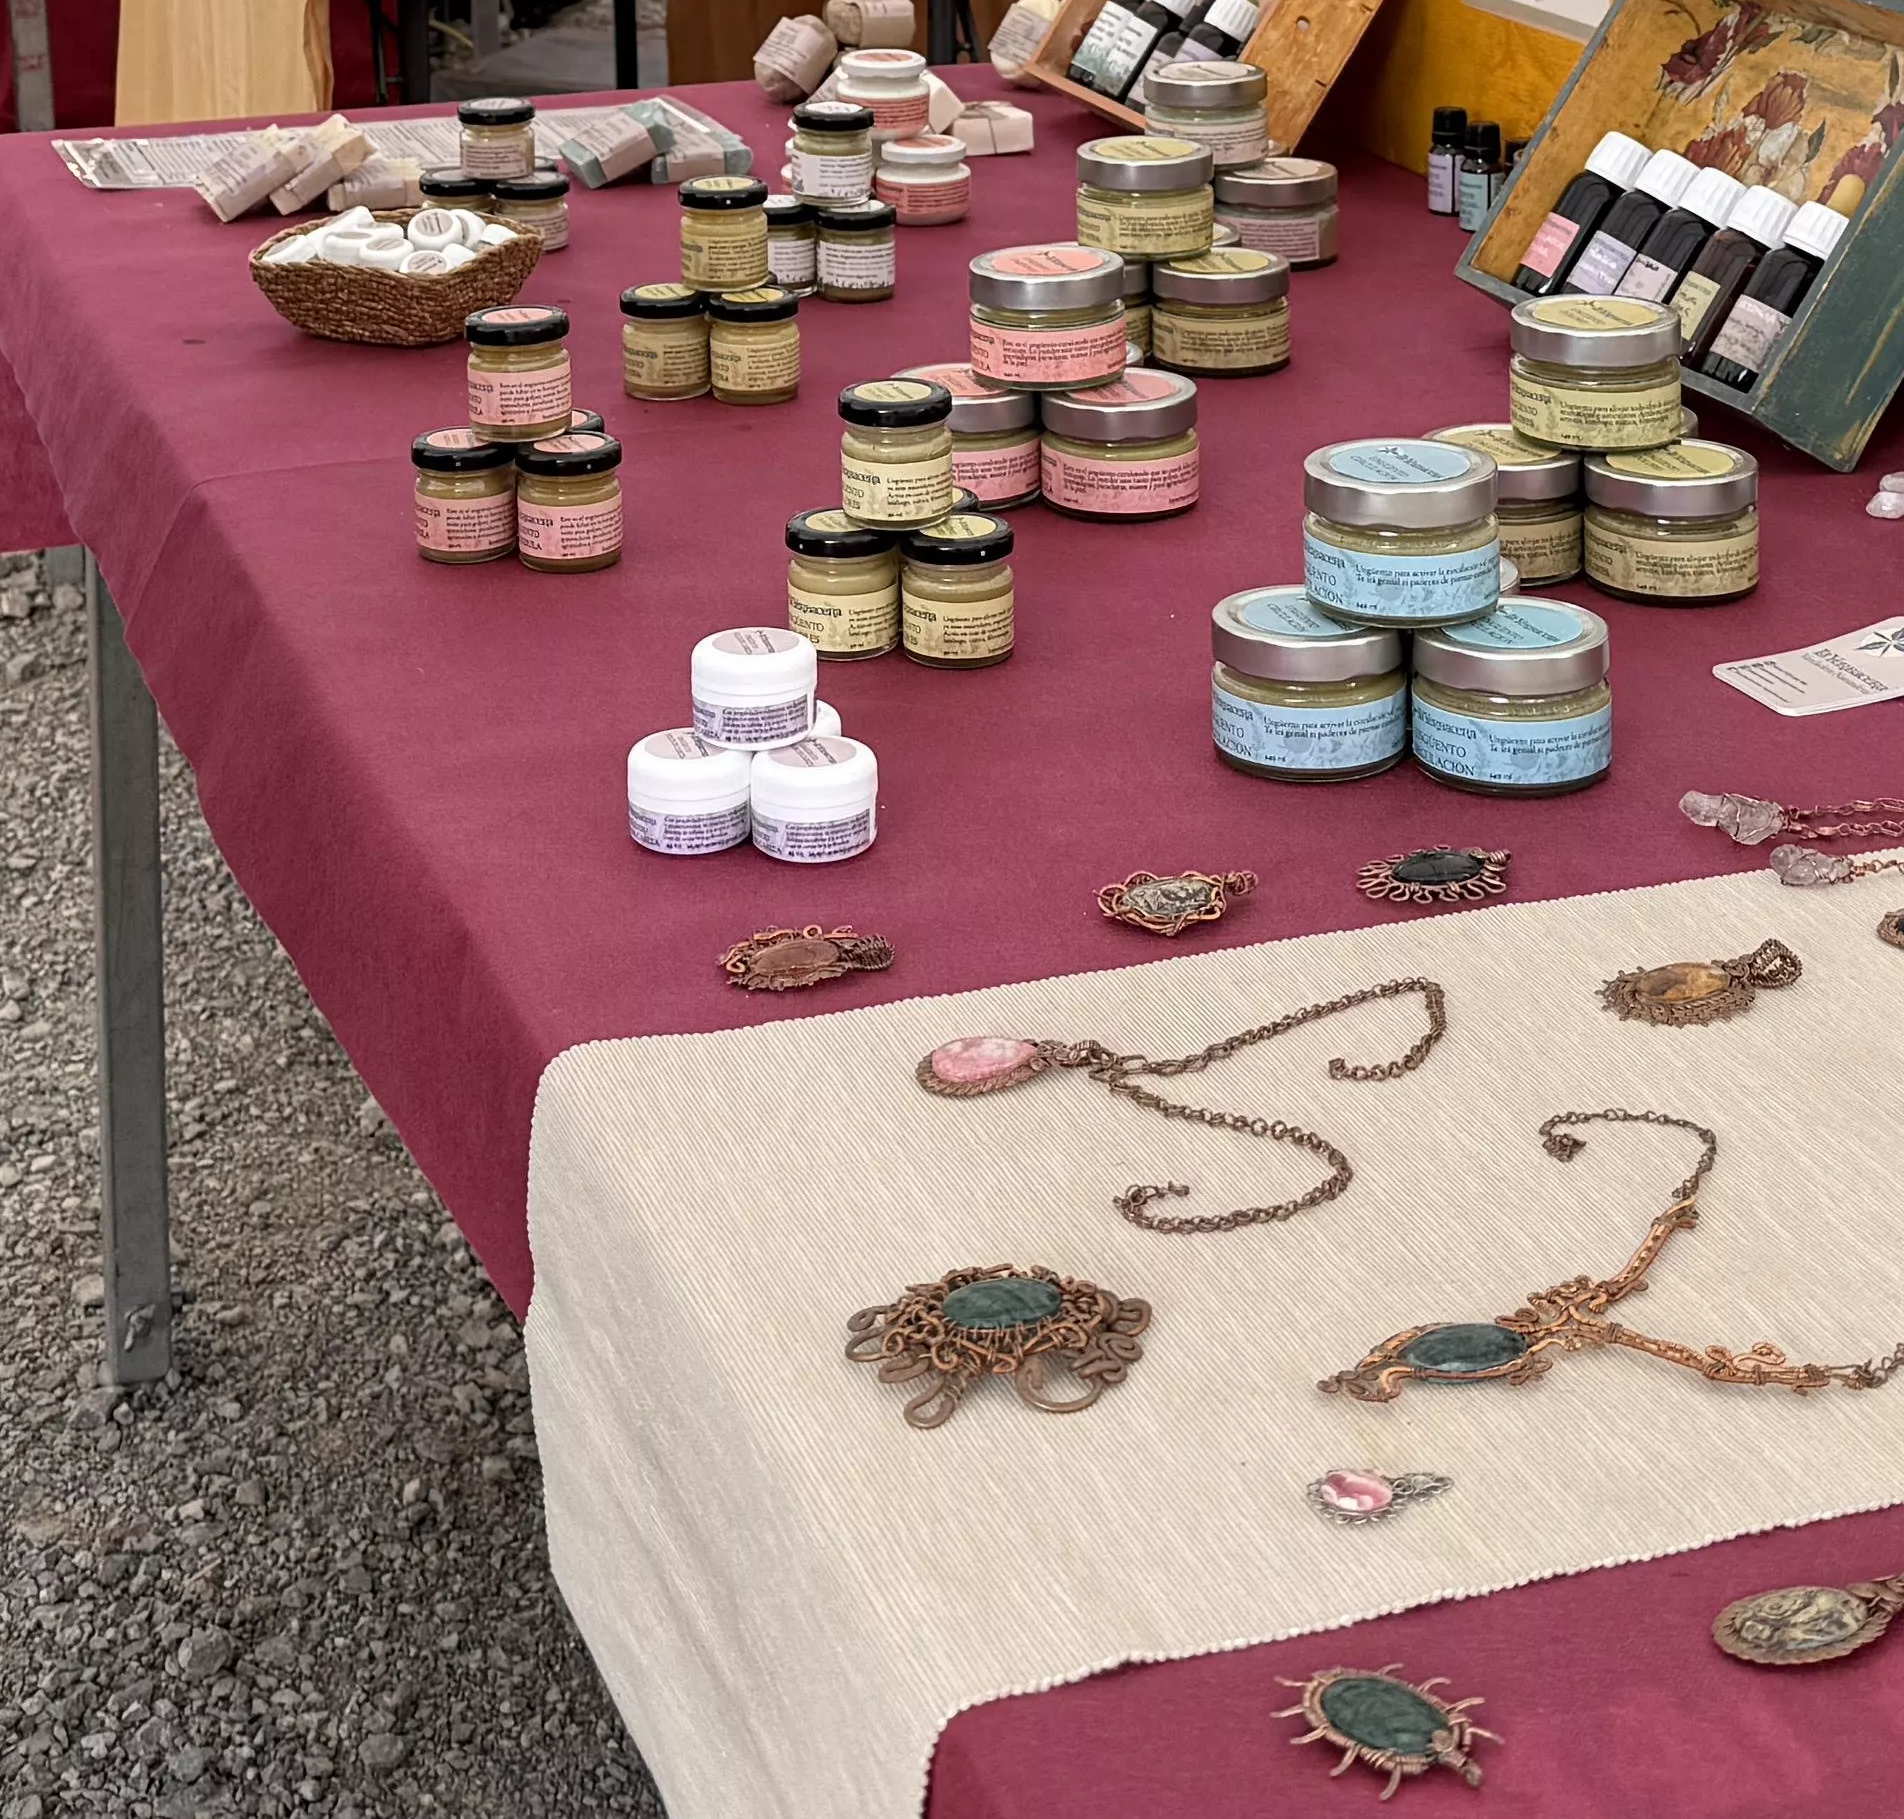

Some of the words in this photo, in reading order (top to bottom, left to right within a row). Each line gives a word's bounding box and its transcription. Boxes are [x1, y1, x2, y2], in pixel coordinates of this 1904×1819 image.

[1394, 569, 1411, 579] para
[1438, 567, 1445, 577] la
[1376, 576, 1402, 587] genial
